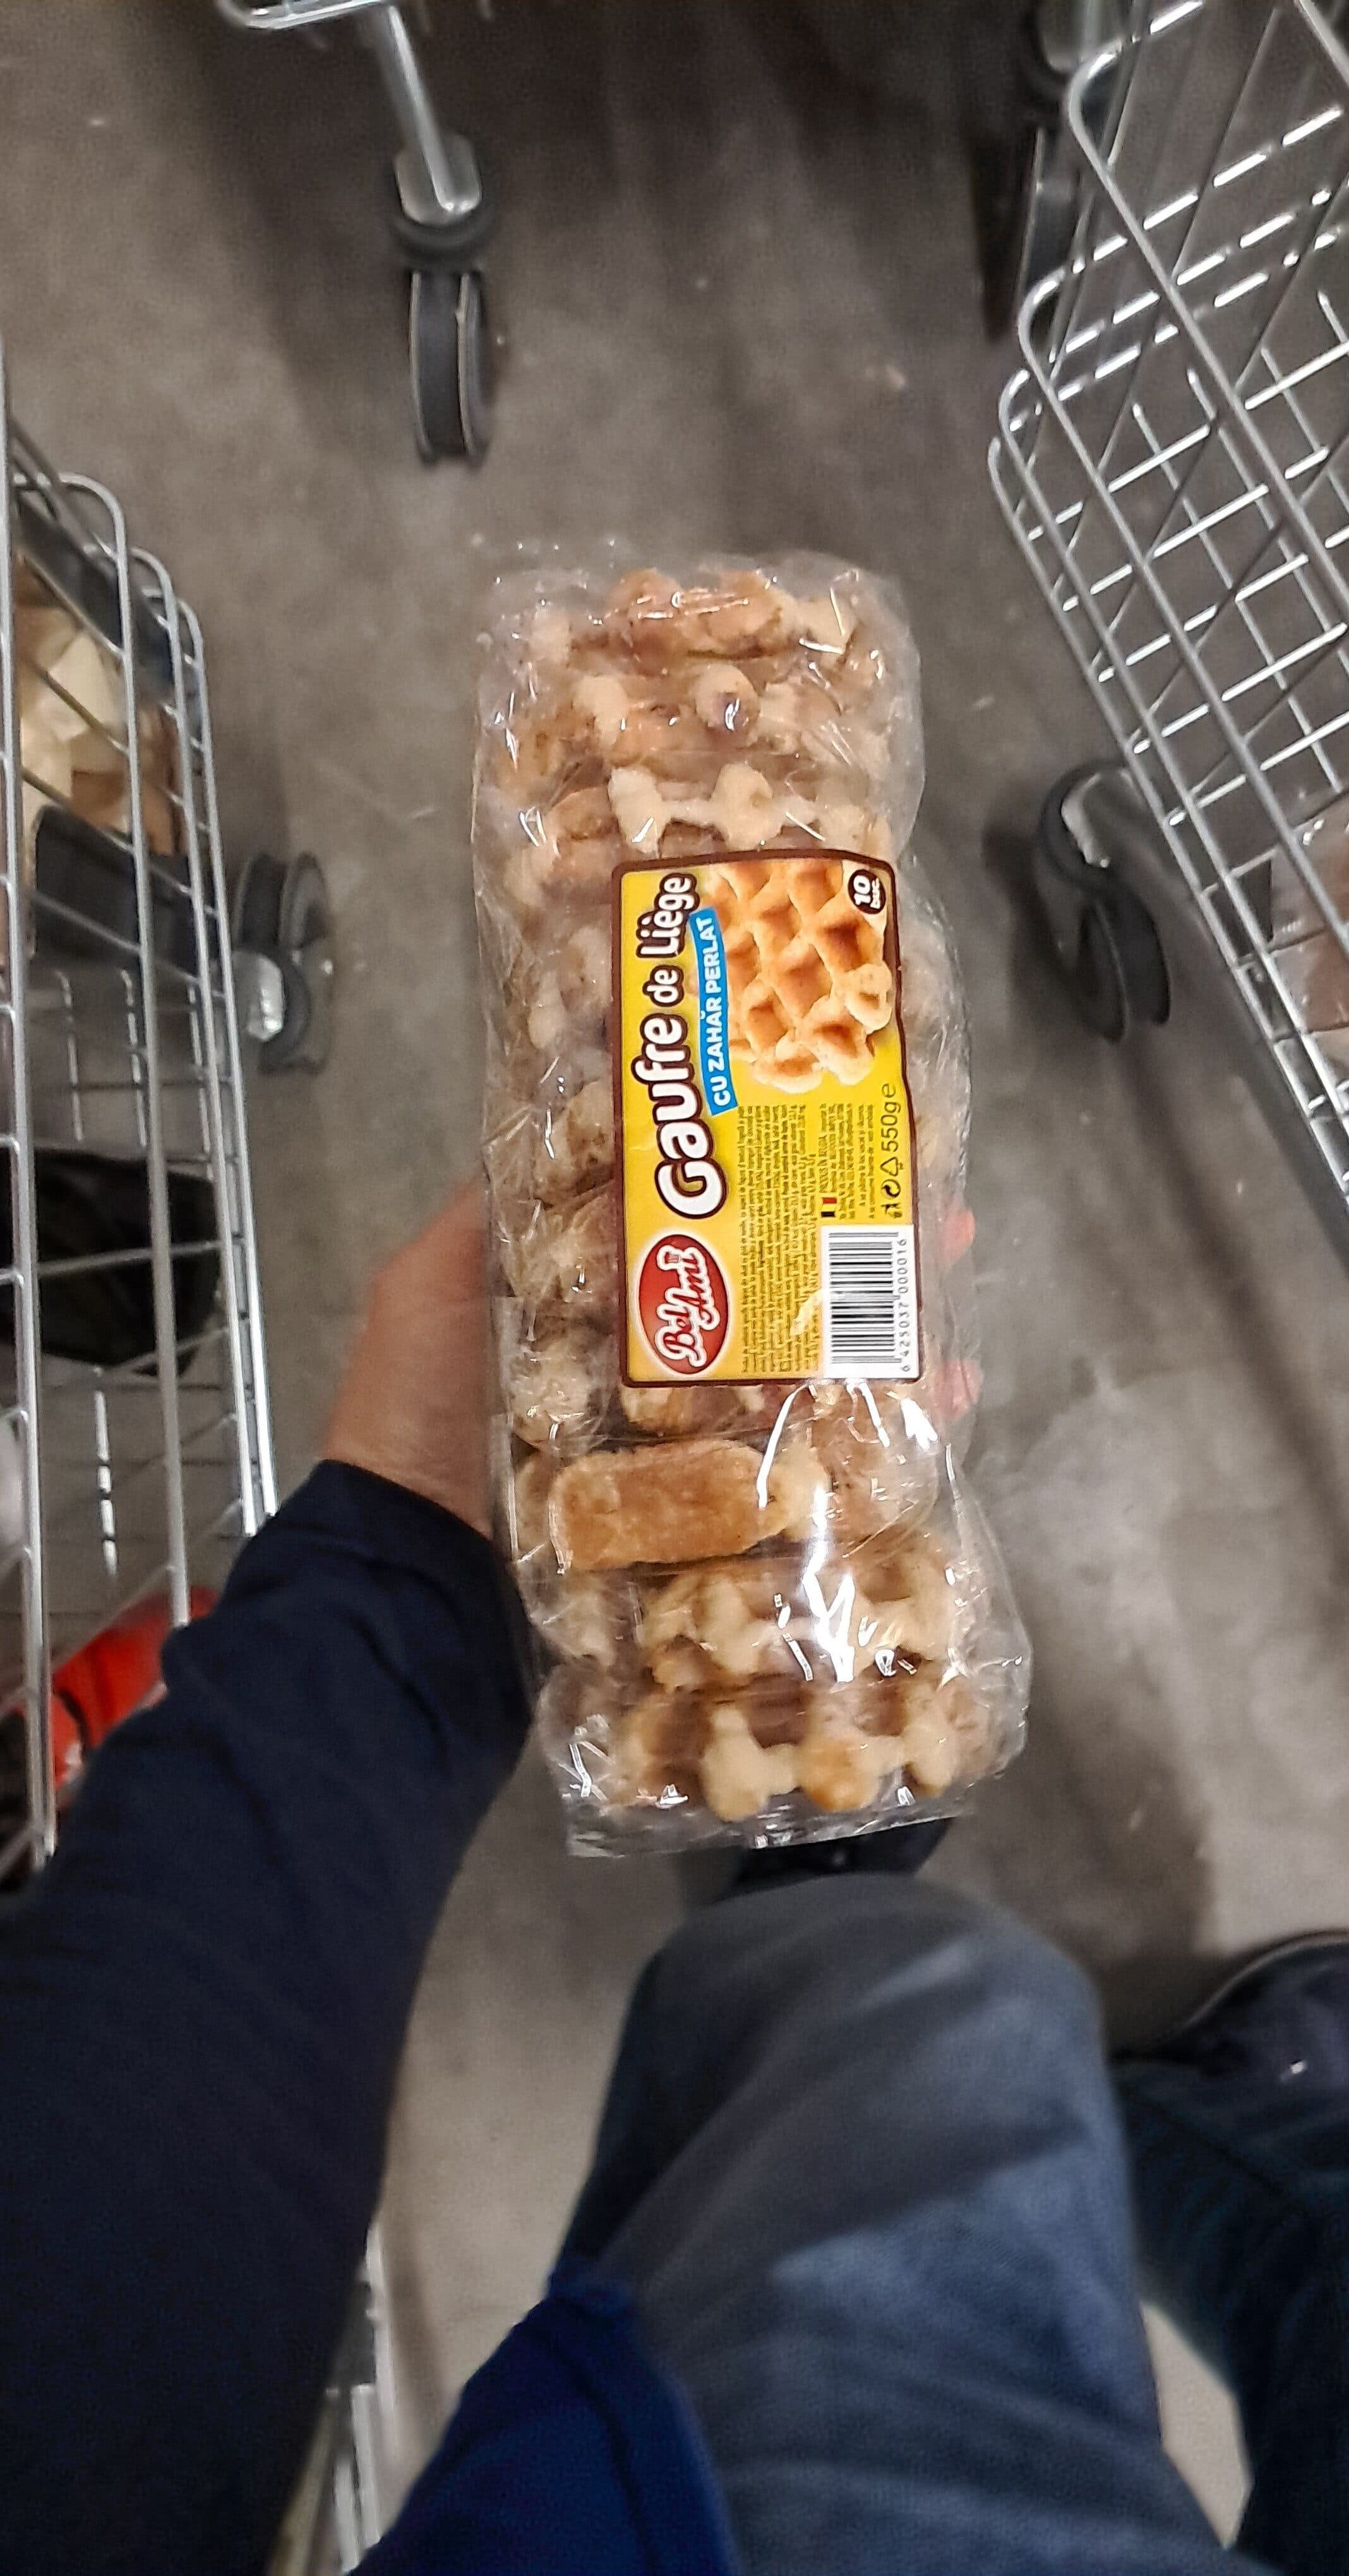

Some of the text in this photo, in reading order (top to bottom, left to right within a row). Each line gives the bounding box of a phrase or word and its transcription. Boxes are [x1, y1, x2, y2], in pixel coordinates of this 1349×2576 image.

[853, 874, 872, 905] 10
[695, 917, 731, 1106] CU ZAHĂR PERLAT
[633, 876, 724, 1217] Gaufre de Liège
[662, 1248, 716, 1327] Ami
[896, 1238, 909, 1294] 000016
[660, 1304, 702, 1364] Bel
